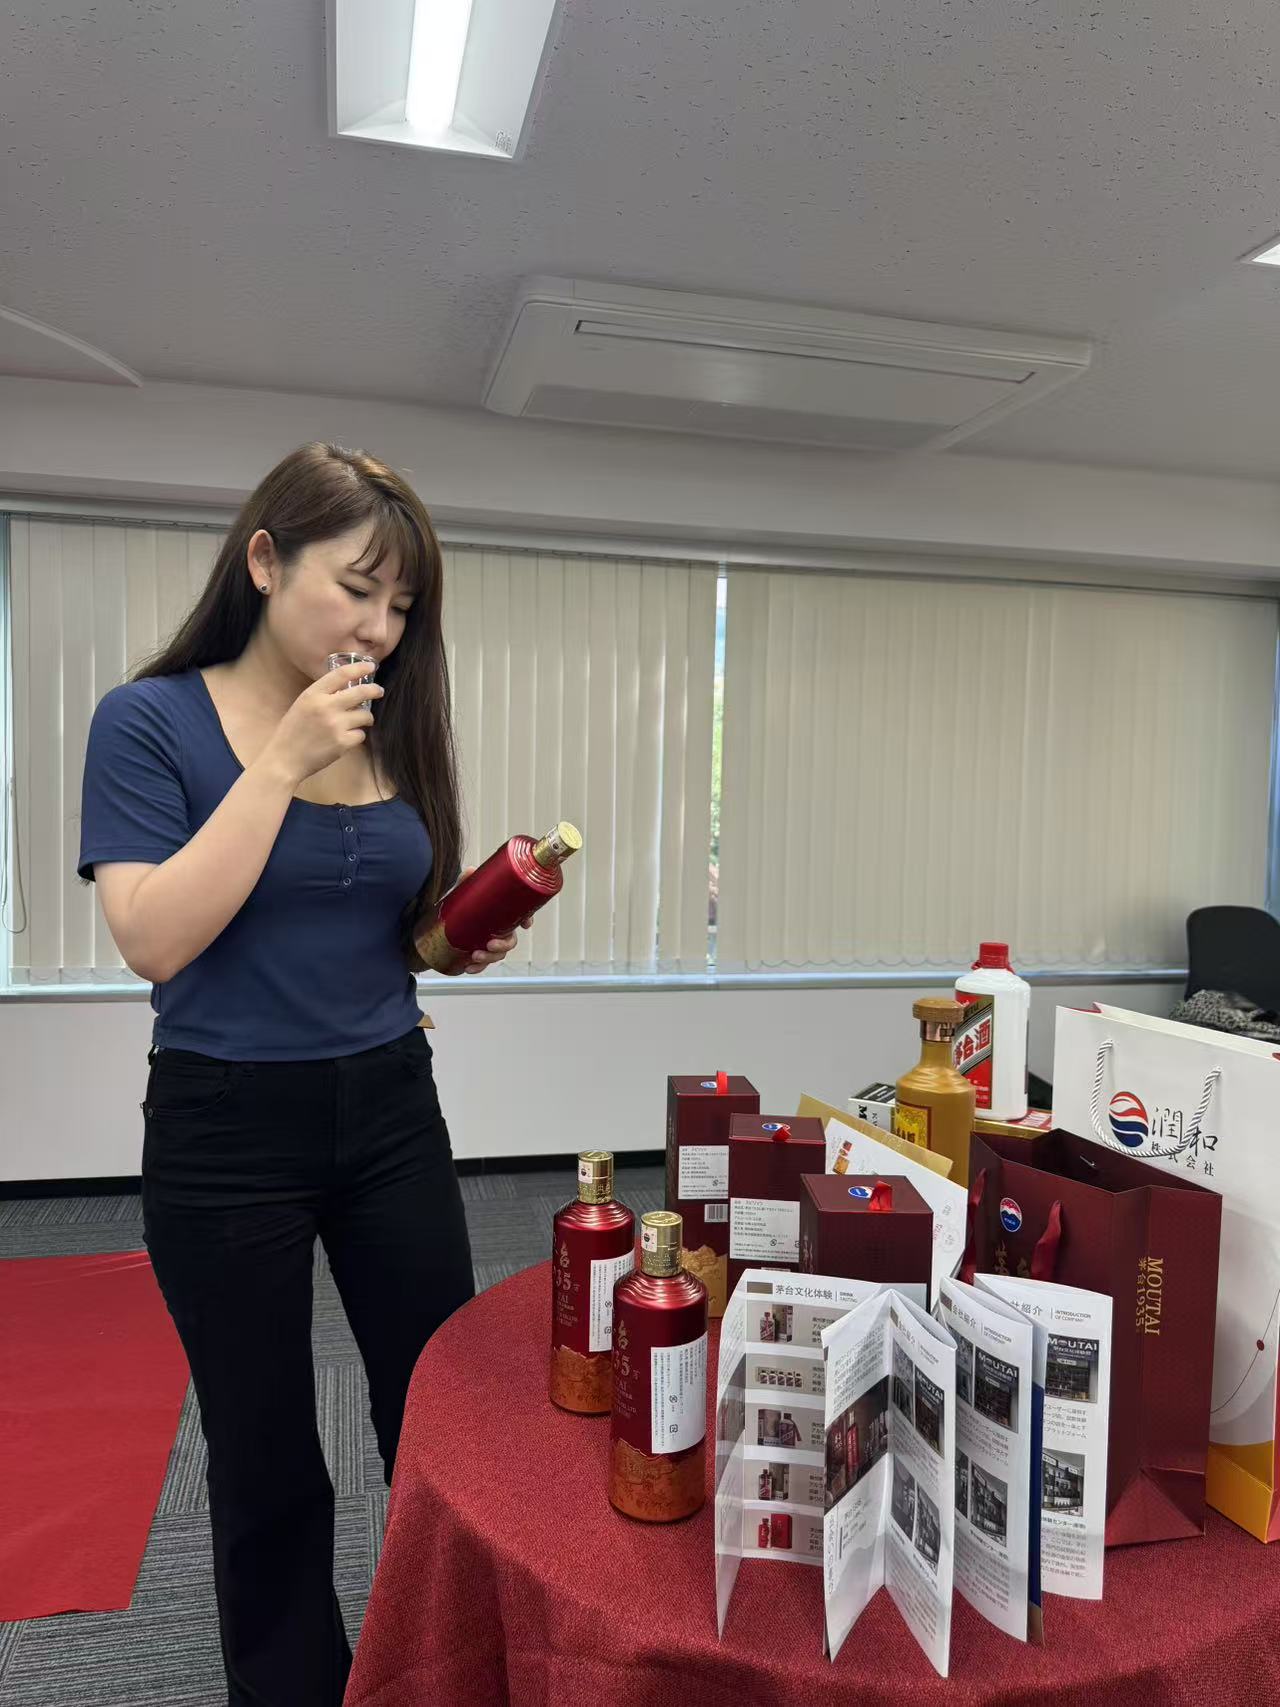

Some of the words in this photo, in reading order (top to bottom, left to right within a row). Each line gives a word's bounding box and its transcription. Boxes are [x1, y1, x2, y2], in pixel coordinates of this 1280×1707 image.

[775, 1284, 833, 1300] 茅台文化体験
[1144, 1256, 1164, 1336] MOUTAI
[1055, 1310, 1091, 1319] INTRODUCTION
